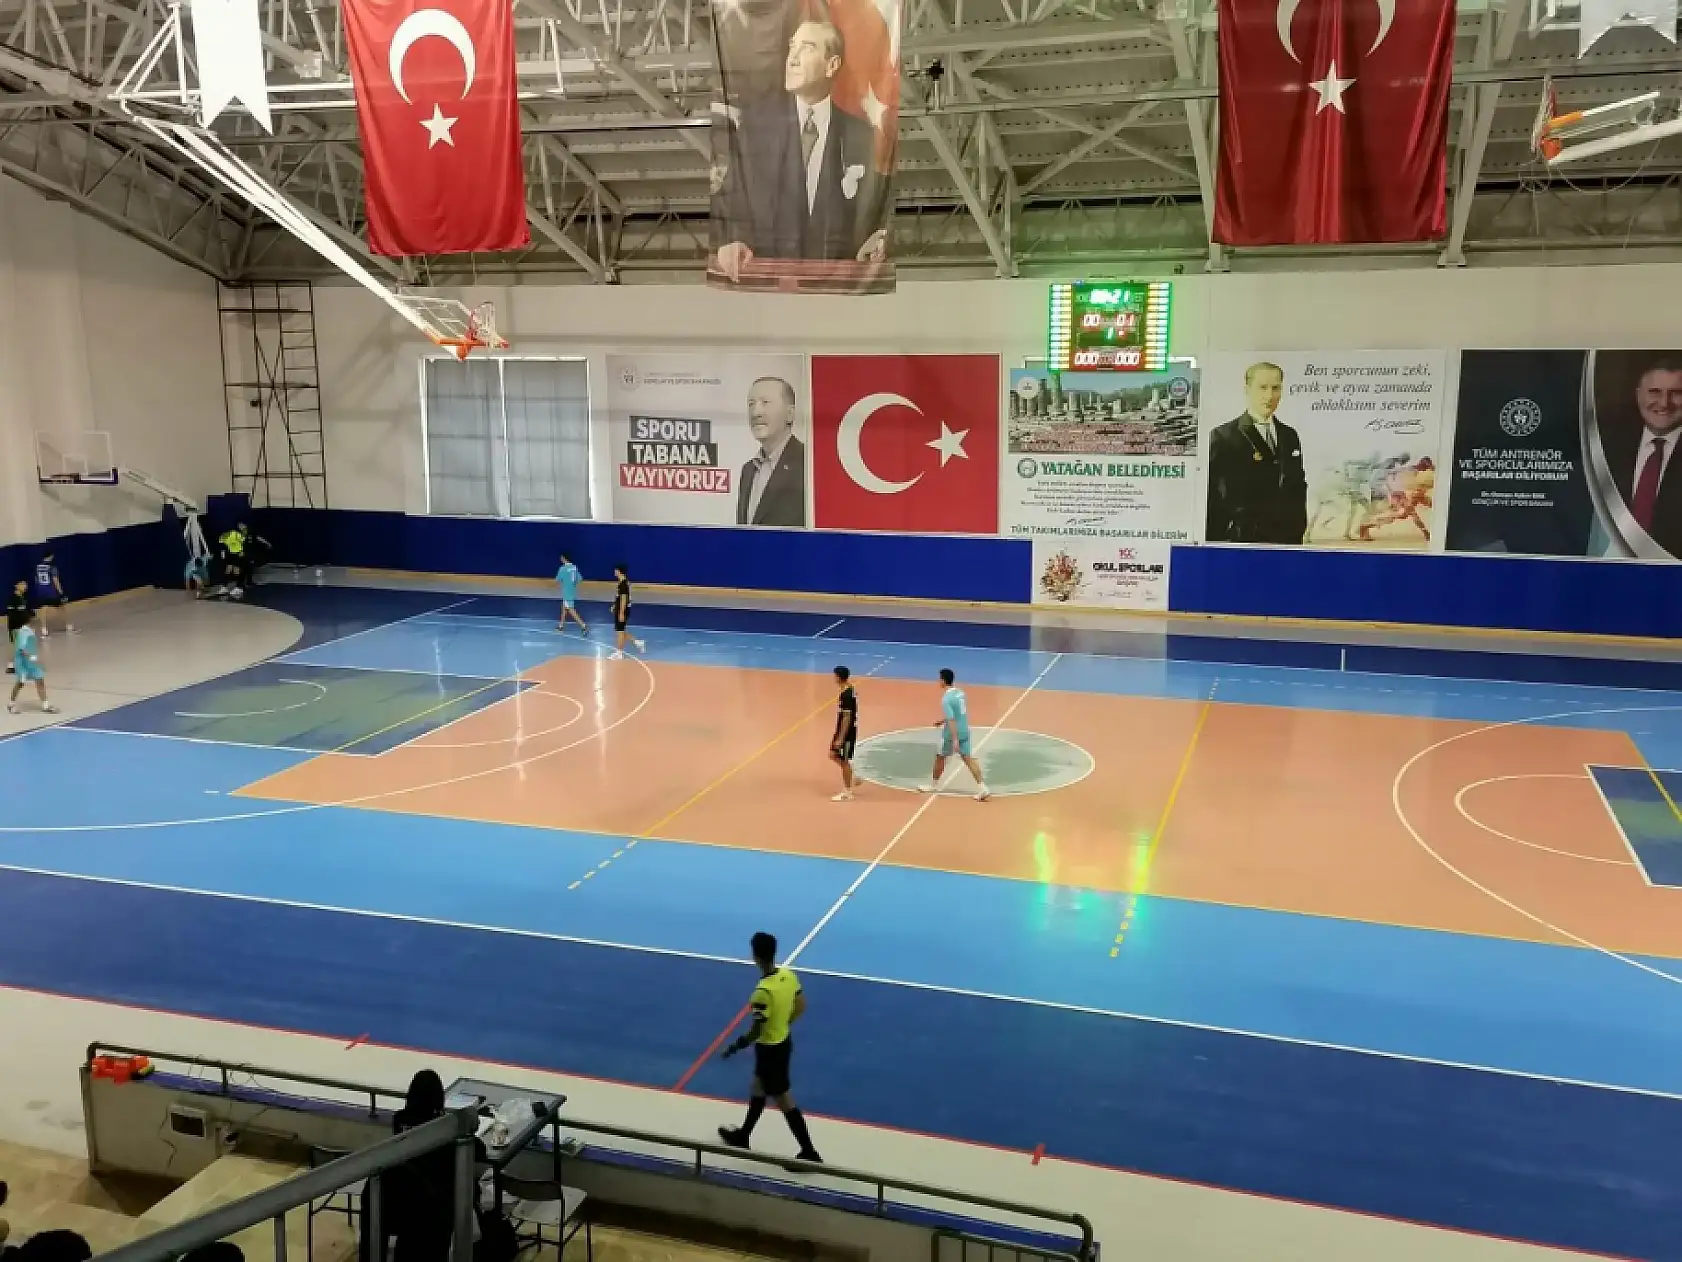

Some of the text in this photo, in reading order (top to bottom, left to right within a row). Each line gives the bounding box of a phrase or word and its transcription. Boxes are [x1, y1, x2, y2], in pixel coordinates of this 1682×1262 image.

[1304, 363, 1431, 379] Ben sporcunun zeki,
[1289, 380, 1321, 395] çevik
[1326, 383, 1340, 393] ve
[1374, 380, 1433, 394] zamanda
[1380, 399, 1431, 411] severim
[636, 418, 701, 442] SPORU
[632, 444, 711, 465] TABANA
[1472, 447, 1562, 460] TÜM ANTRENÖR
[1040, 459, 1186, 478] YATAĞAN BELEDİYESİ
[1459, 459, 1574, 471] VE SPORCULARIMIZA
[622, 465, 728, 491] YAYIYORUZ
[1462, 470, 1513, 480] BAŞARILAR
[1010, 524, 1029, 535] TÜM
[1030, 525, 1098, 537] TAKIMLARIMIZA
